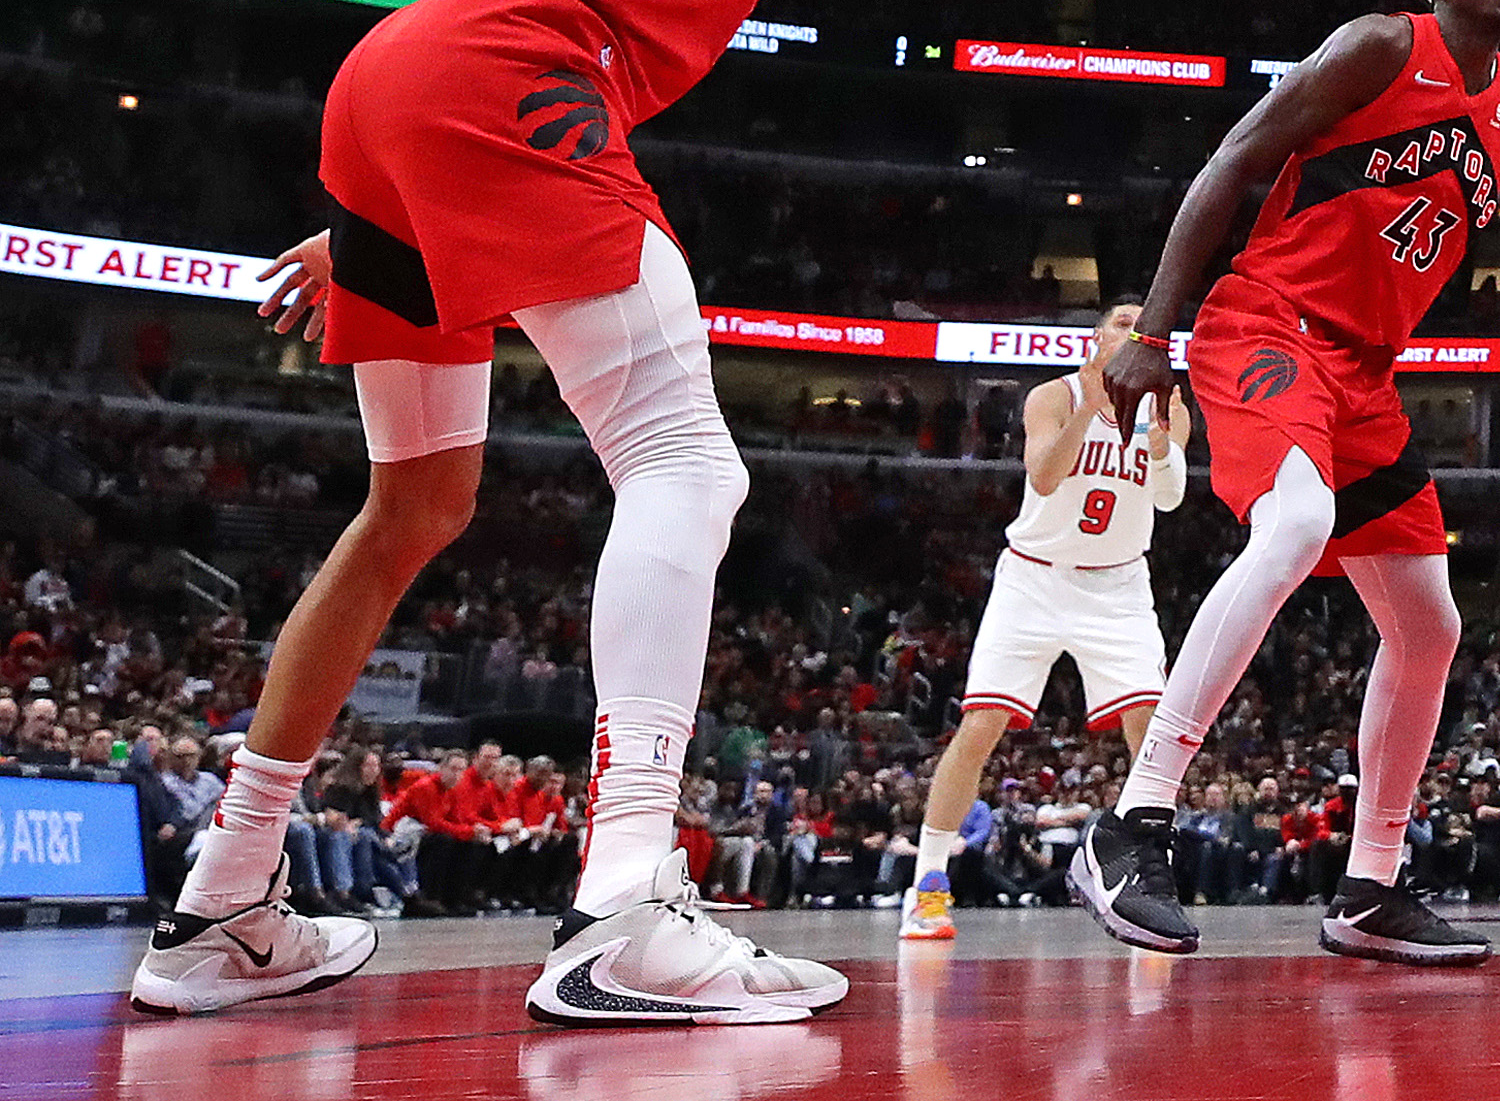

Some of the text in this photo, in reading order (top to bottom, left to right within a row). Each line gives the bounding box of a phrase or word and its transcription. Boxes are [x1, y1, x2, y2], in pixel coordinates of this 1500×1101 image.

[768, 22, 819, 44] KNIGHTS
[967, 43, 1077, 71] Budweiser
[1083, 55, 1171, 78] CHAMPIONS
[1171, 62, 1211, 80] CLUB
[1364, 127, 1498, 229] RAPTORS
[1378, 195, 1463, 273] 43
[0, 232, 242, 289] RST ALERT
[712, 314, 728, 333] &
[728, 315, 796, 339] Families
[796, 322, 843, 342] Since
[988, 330, 1094, 359] FIRST
[1435, 347, 1491, 363] ALERT
[1067, 439, 1149, 487] ULLS
[1078, 487, 1118, 536] 9
[10, 808, 85, 866] AT&T
